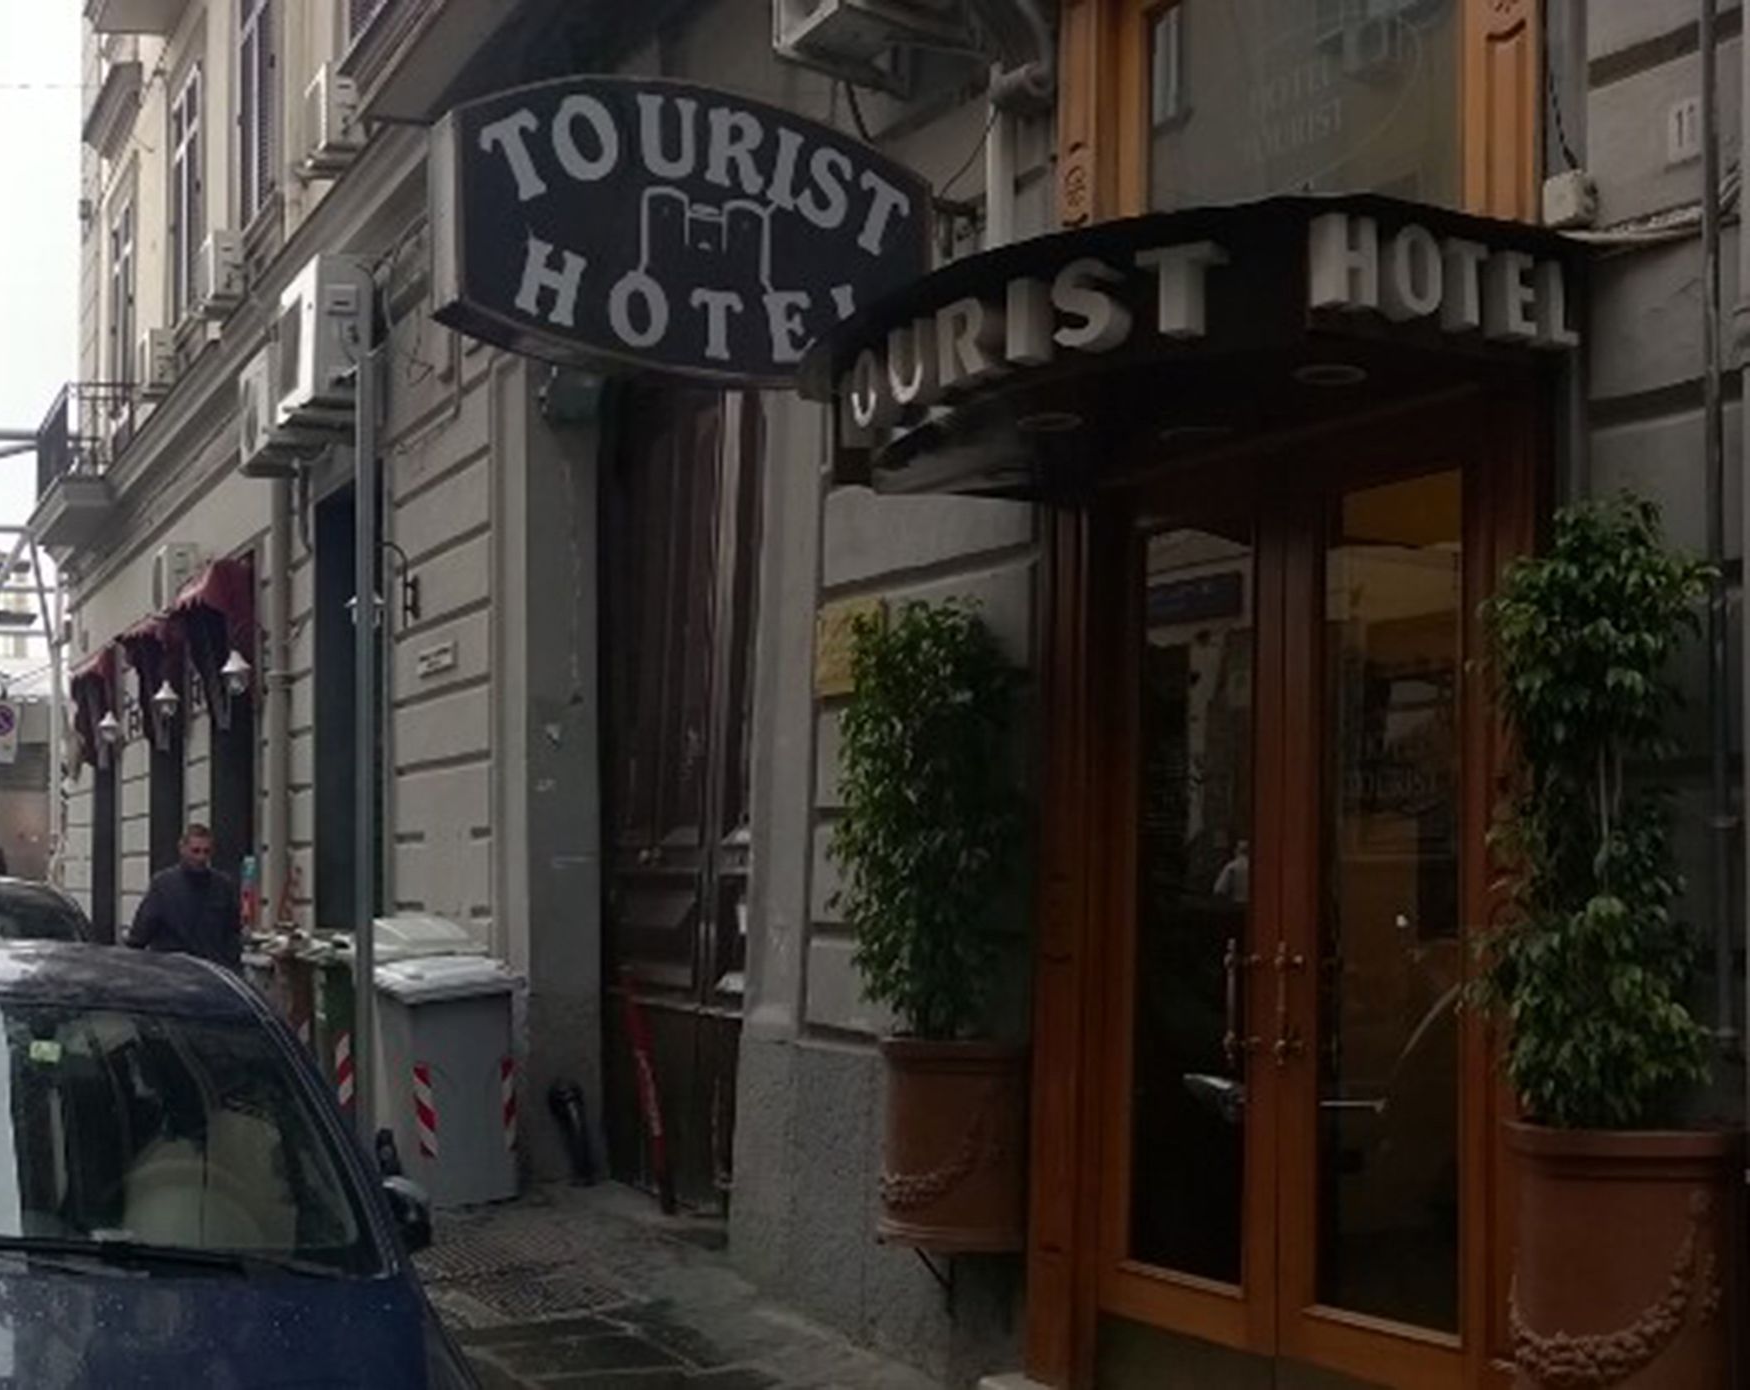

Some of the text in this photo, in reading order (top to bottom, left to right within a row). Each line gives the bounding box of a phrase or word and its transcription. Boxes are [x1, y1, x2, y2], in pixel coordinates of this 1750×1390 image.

[479, 93, 910, 256] TOURIST
[842, 213, 1579, 429] OURIST HOTEL
